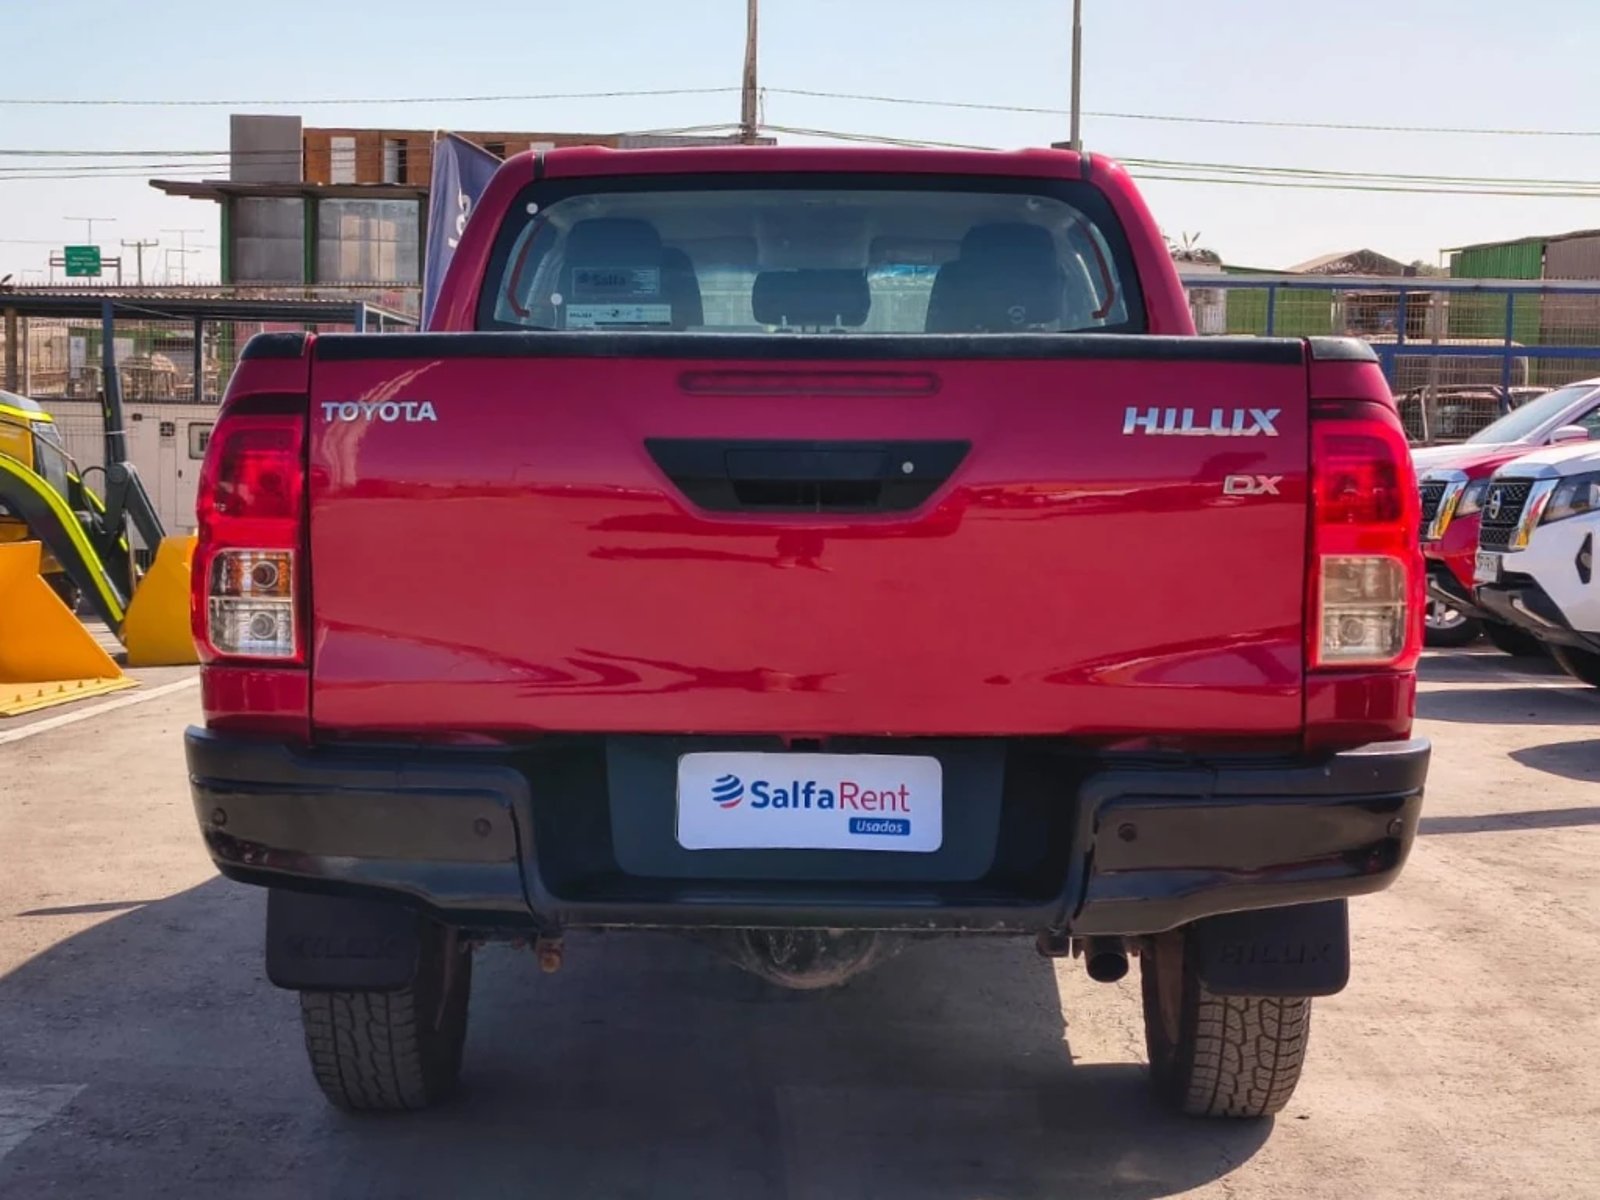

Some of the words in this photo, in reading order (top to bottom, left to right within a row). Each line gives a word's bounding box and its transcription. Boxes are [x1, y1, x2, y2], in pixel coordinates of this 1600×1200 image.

[321, 401, 437, 421] TOYOTA
[1122, 406, 1281, 437] HILUX
[1223, 475, 1283, 494] DX
[750, 780, 911, 812] SalfaRent
[856, 820, 903, 834] Usados
[1219, 943, 1331, 964] HILUX
